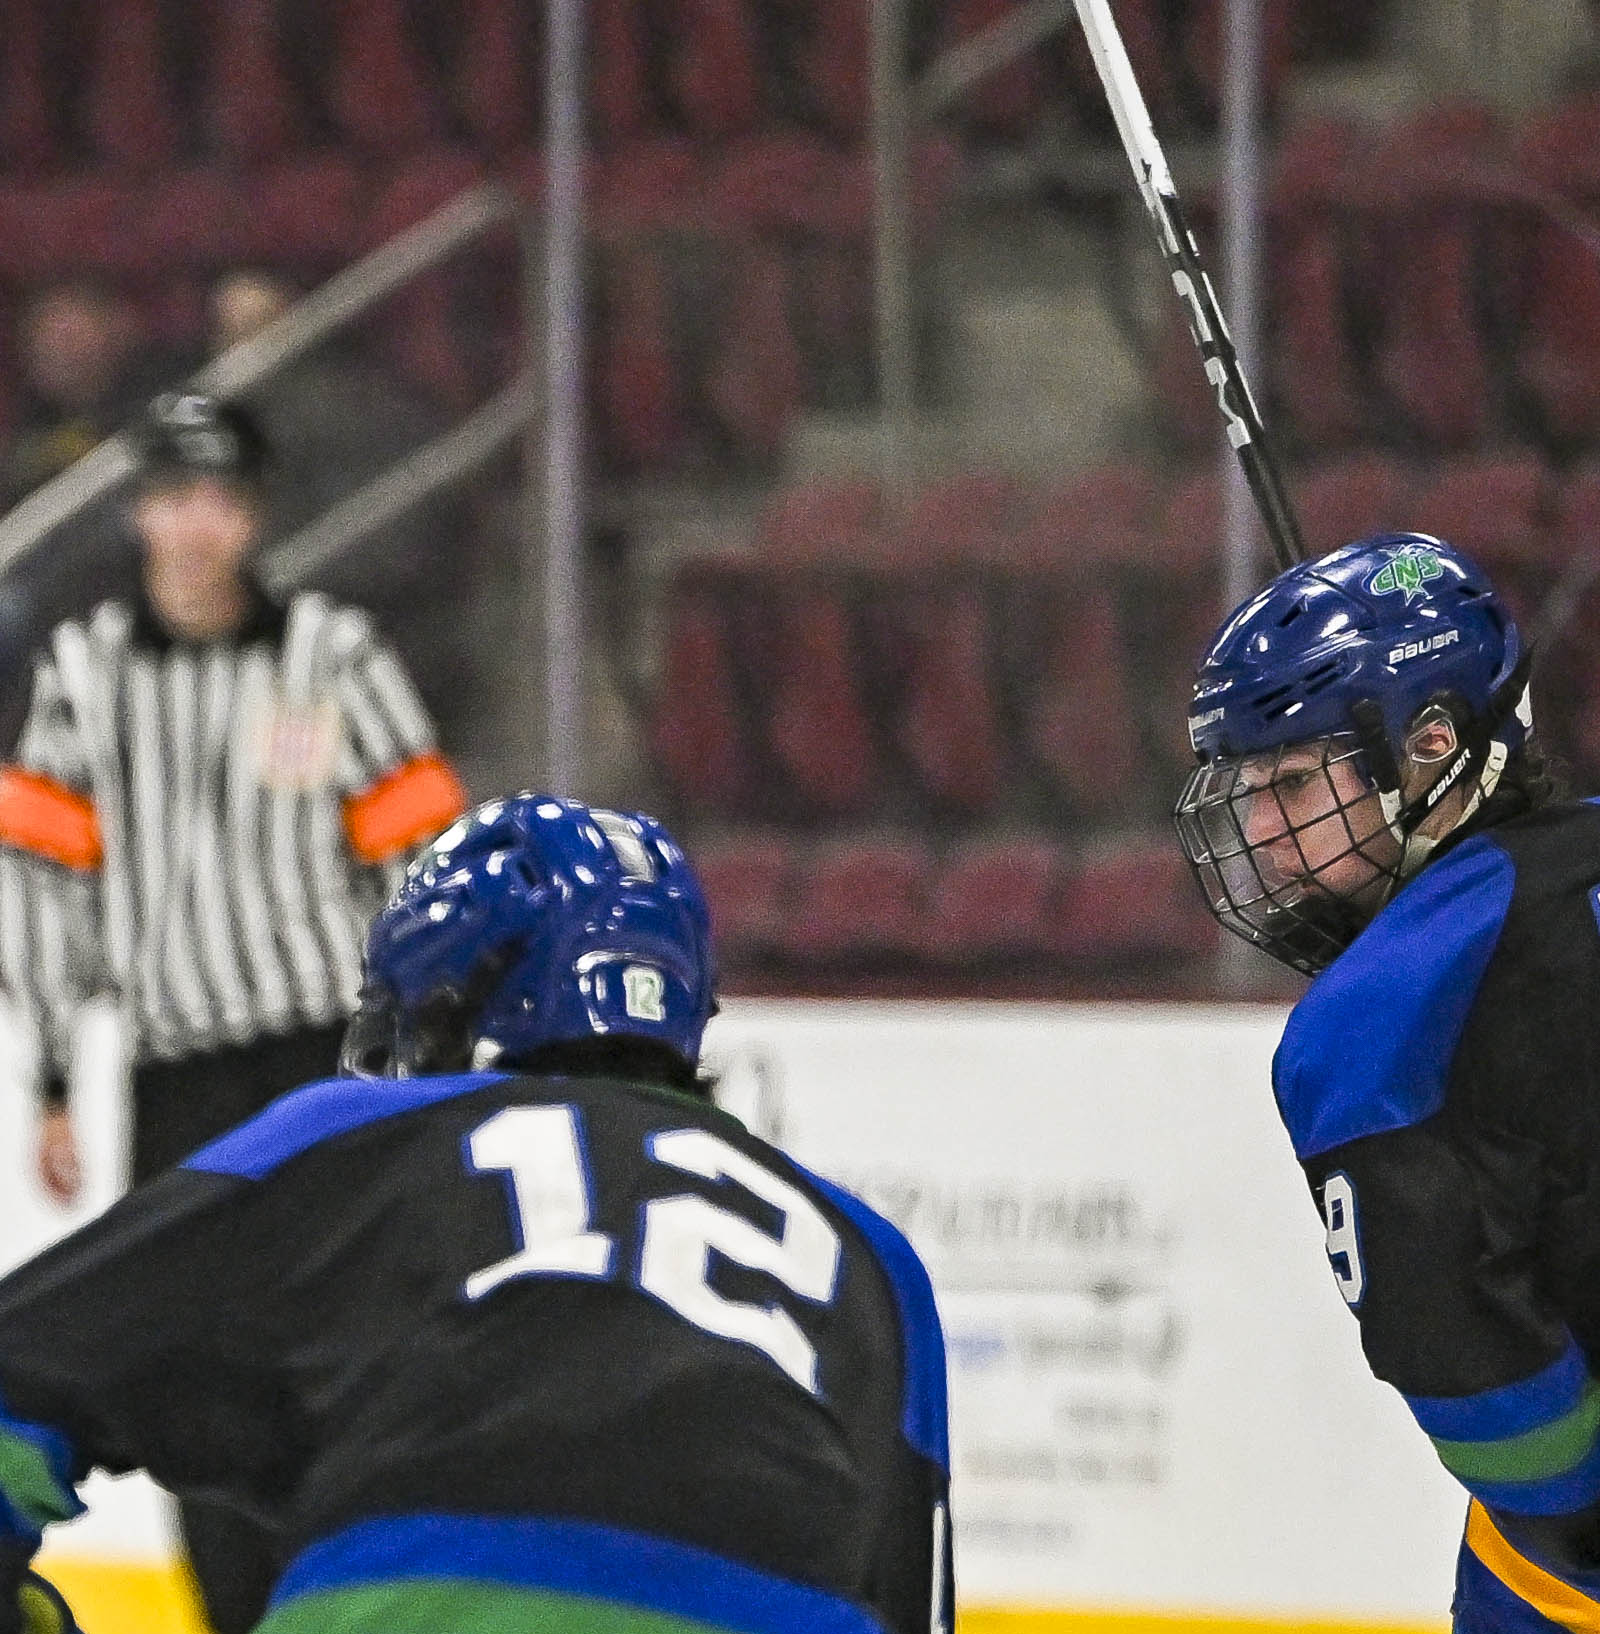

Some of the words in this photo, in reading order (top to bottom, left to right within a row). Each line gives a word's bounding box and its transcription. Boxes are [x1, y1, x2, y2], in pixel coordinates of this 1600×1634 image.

[1388, 628, 1460, 666] BAUER
[1426, 747, 1473, 808] BAUER
[460, 1102, 841, 1398] 12
[1324, 1171, 1367, 1308] 9
